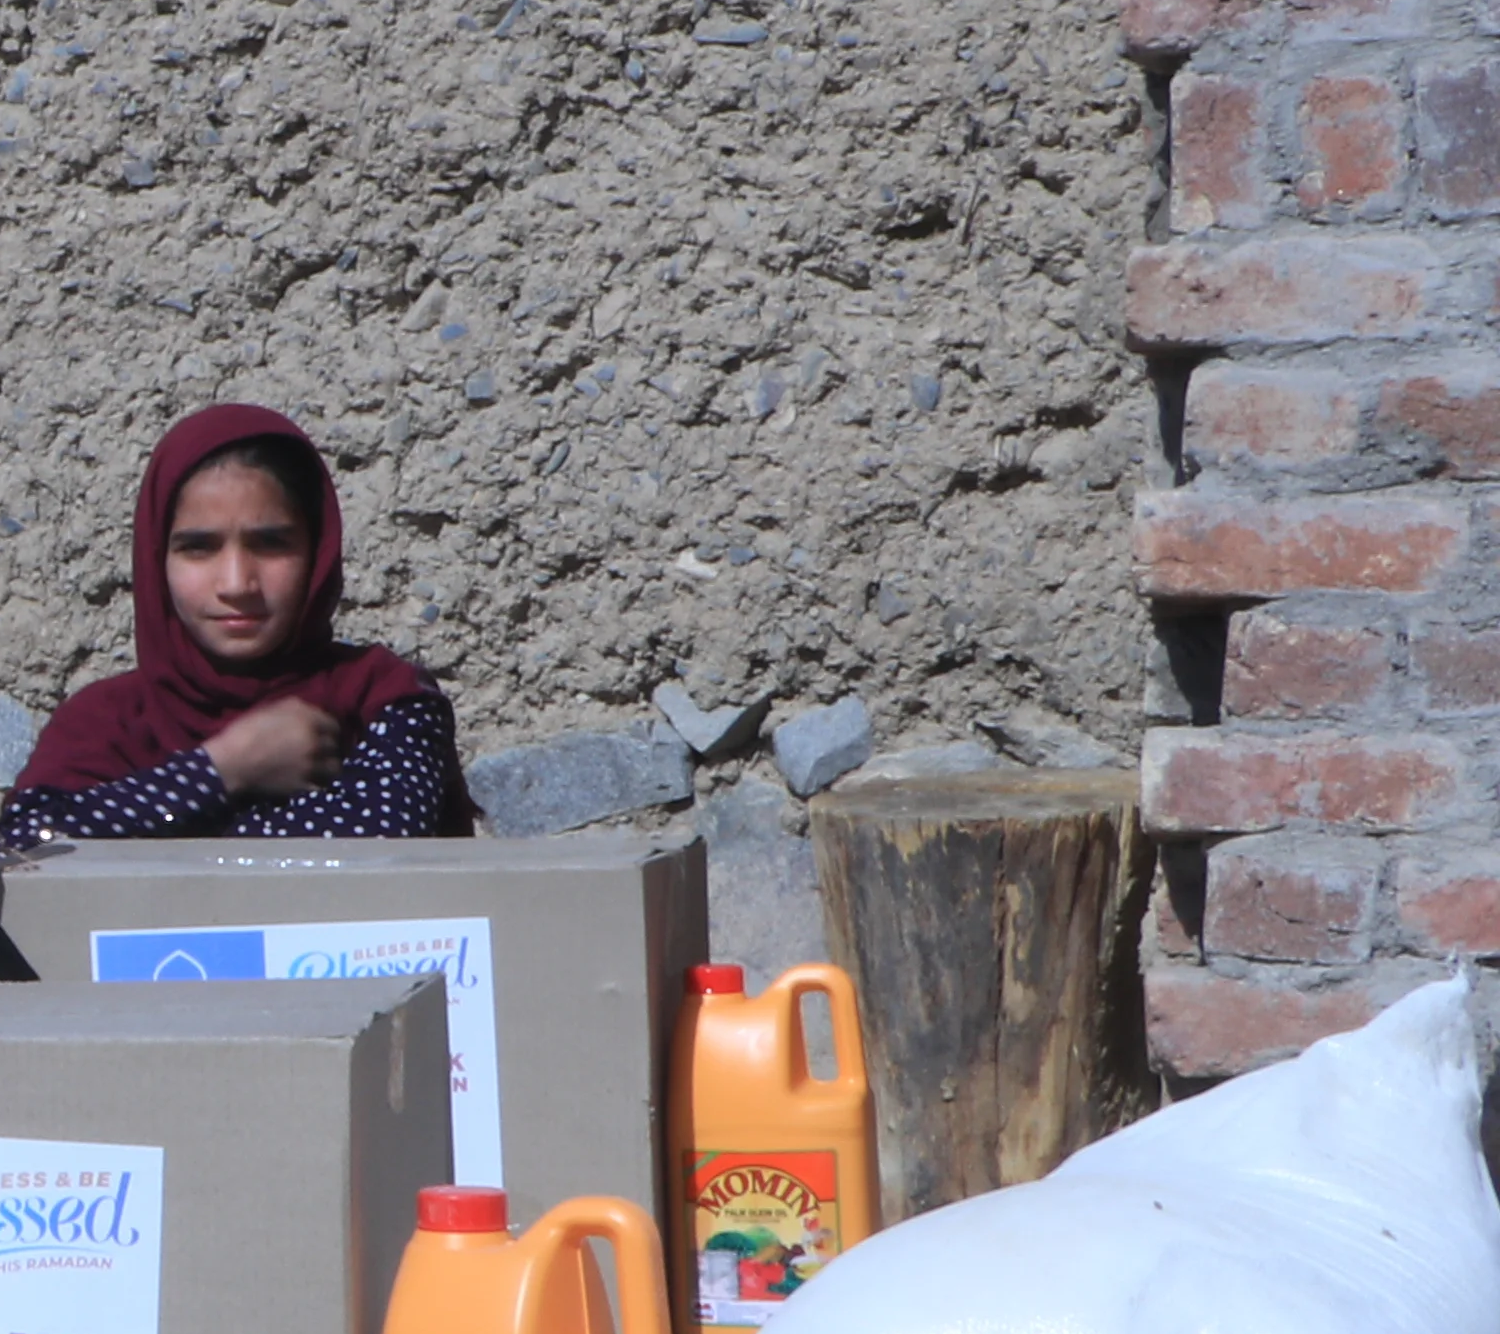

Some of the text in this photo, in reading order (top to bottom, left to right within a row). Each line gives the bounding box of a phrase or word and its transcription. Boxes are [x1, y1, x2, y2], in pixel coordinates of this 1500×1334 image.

[55, 1172, 73, 1188] &
[79, 1171, 112, 1188] BE
[697, 1169, 821, 1217] MOMIN
[26, 1257, 114, 1272] RAMADAN
